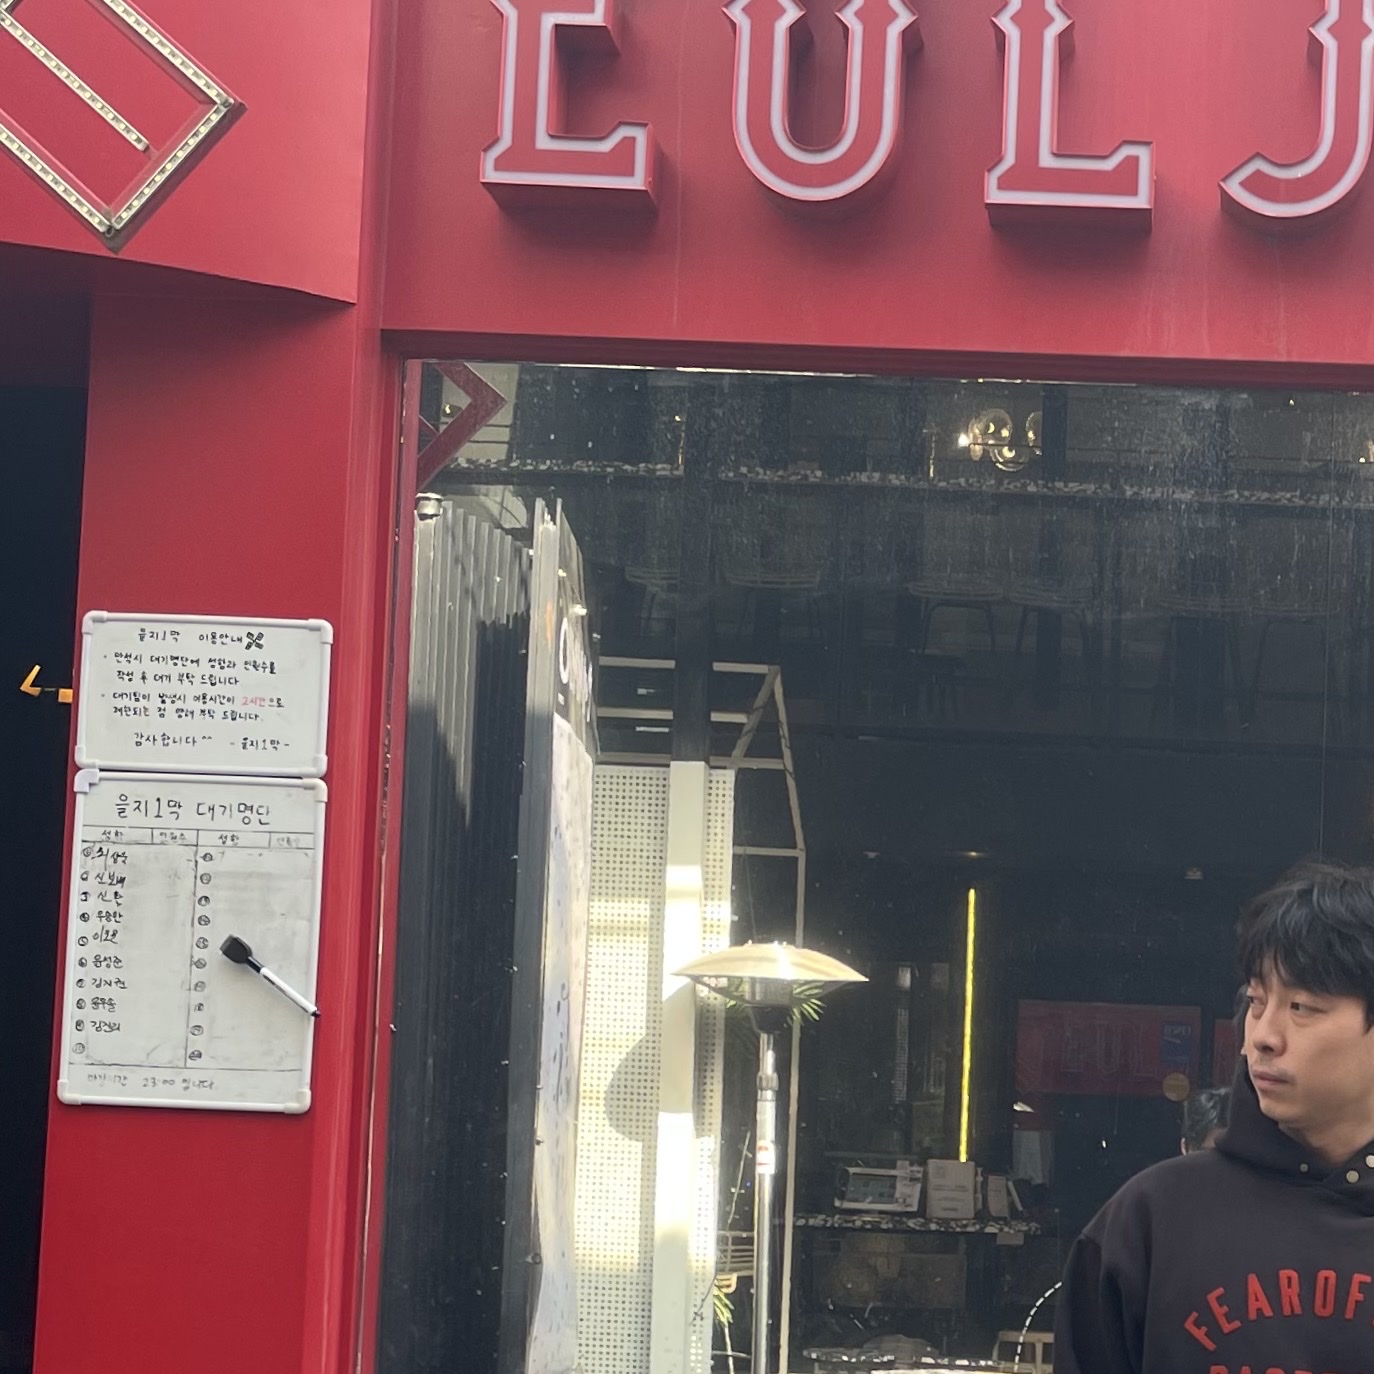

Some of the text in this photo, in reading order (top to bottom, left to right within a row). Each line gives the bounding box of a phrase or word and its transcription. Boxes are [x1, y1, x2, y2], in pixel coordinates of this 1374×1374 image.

[138, 628, 180, 642] 을지1막
[134, 731, 198, 747] 감사합니다
[242, 737, 280, 751] 을지1막
[115, 793, 271, 825] 을지1막 대기명단
